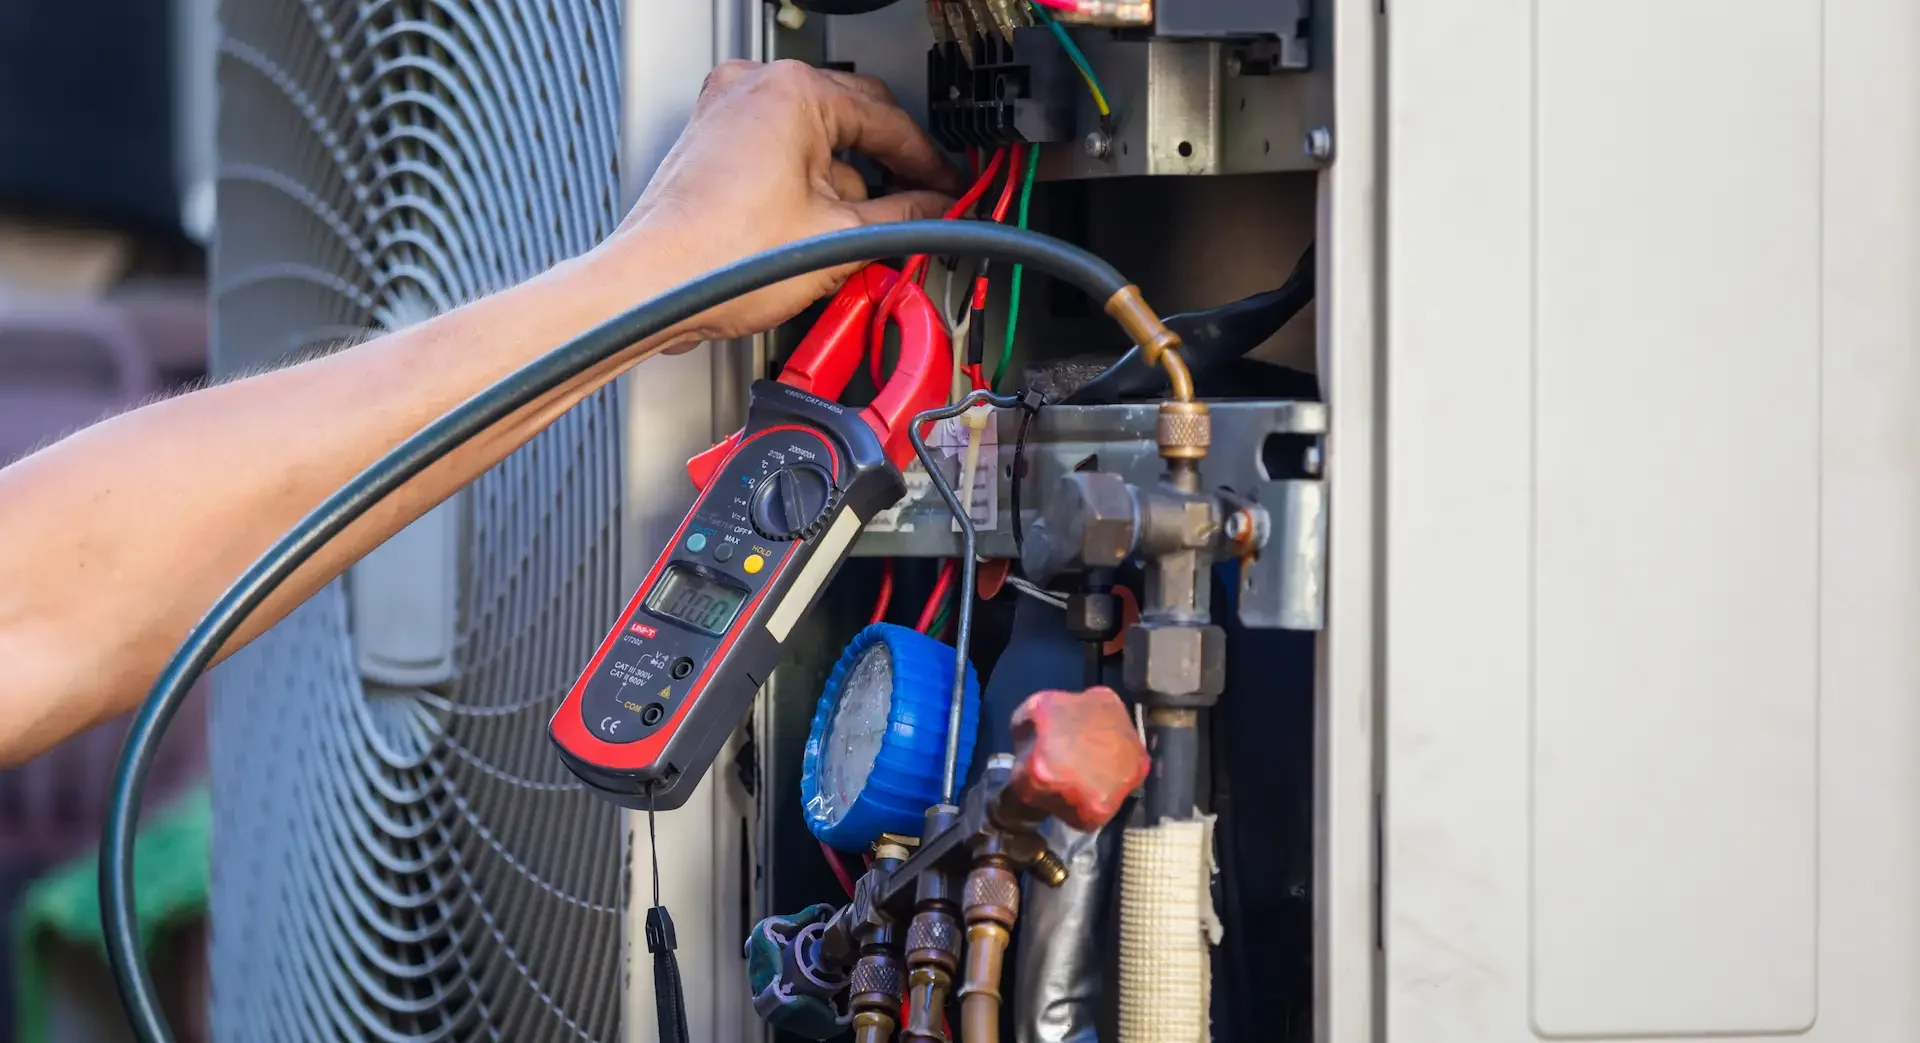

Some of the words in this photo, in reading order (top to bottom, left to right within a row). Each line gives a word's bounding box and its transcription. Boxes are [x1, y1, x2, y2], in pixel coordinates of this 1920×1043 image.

[805, 395, 820, 405] CAT
[734, 526, 748, 535] OFF
[724, 534, 741, 545] MAX
[751, 544, 772, 557] HOLD
[623, 634, 643, 646] UT202
[614, 661, 630, 671] CAT
[628, 666, 637, 674] III
[635, 669, 654, 680] 300V
[609, 668, 625, 679] CAT
[623, 673, 630, 681] II
[628, 675, 647, 687] 600V
[624, 701, 642, 713] COM
